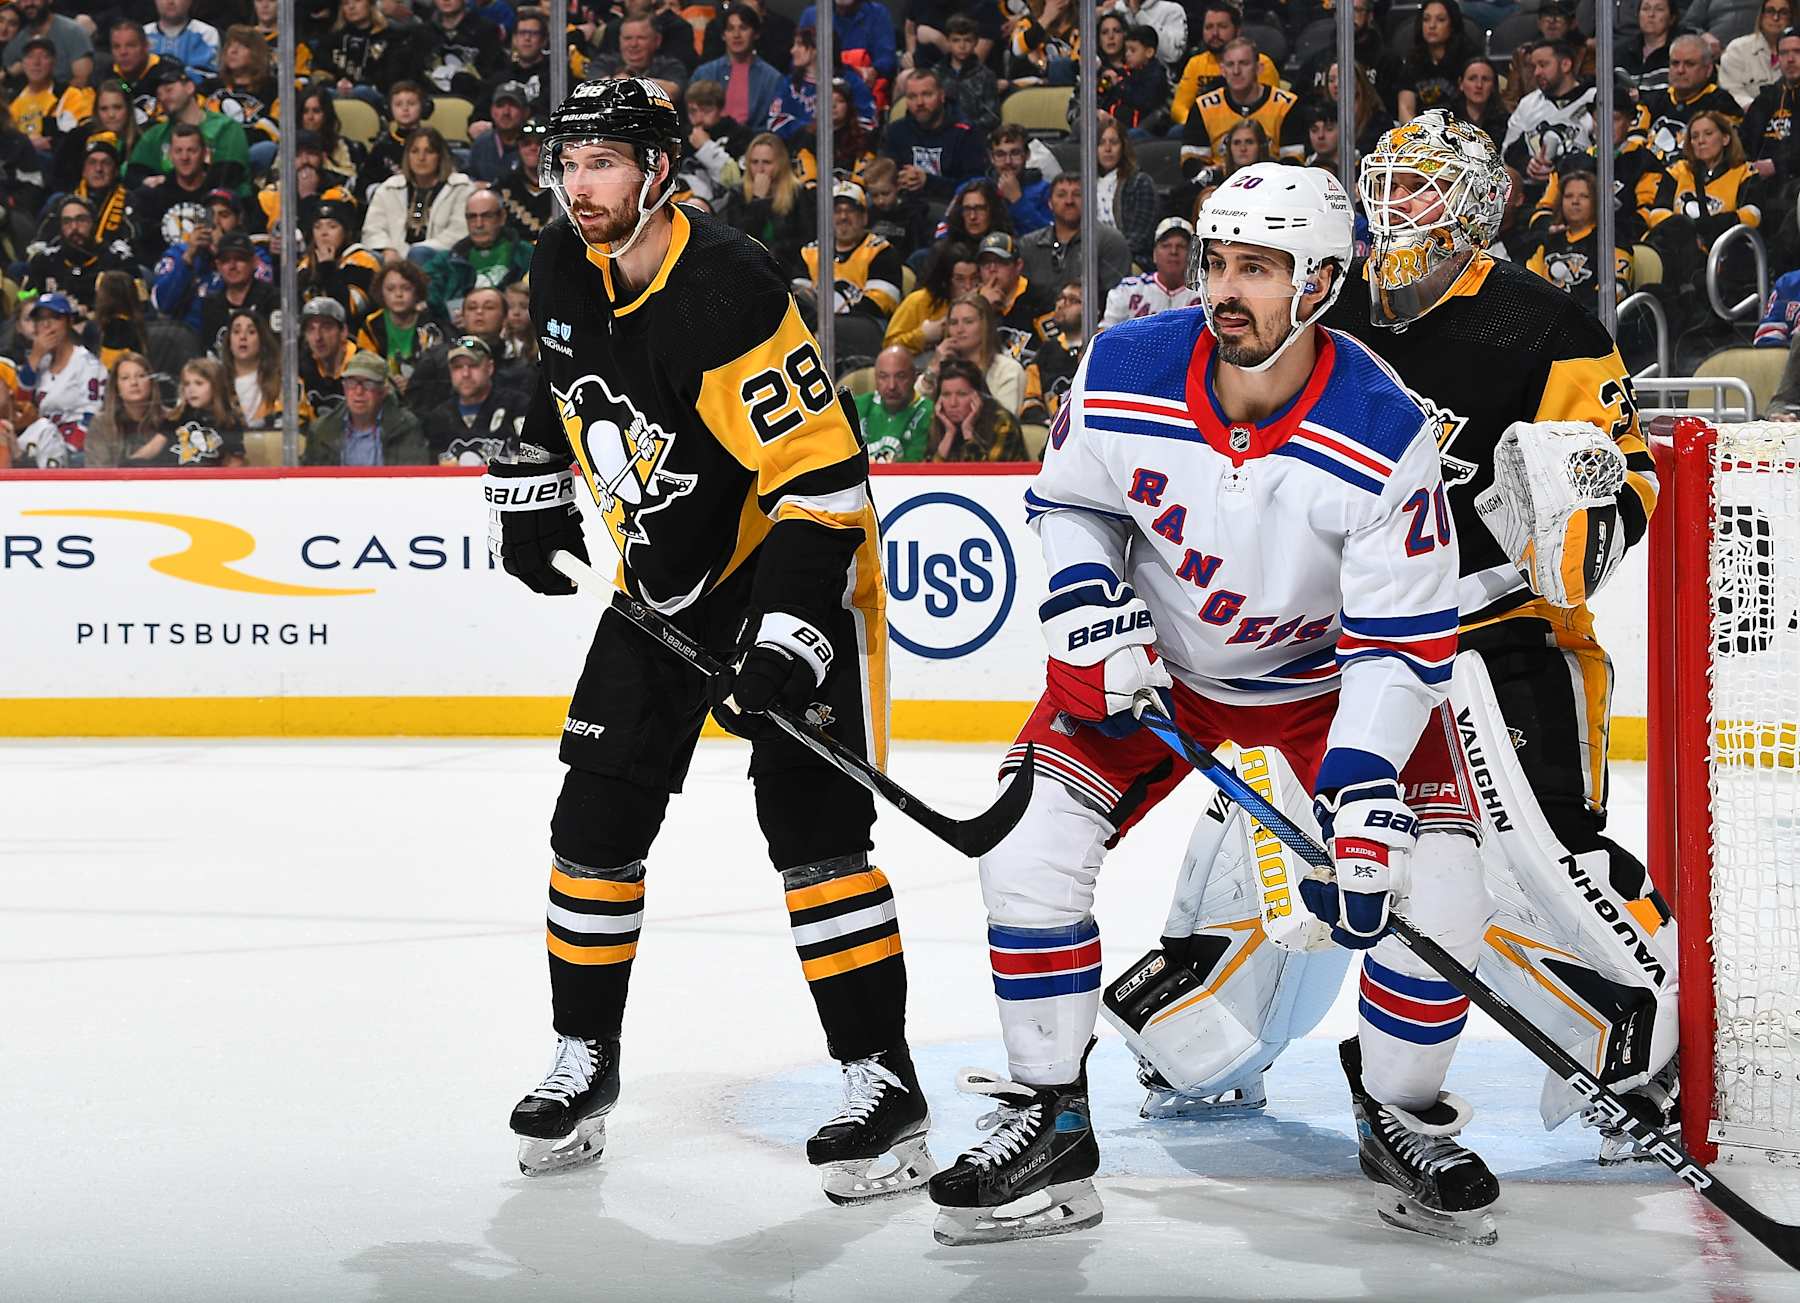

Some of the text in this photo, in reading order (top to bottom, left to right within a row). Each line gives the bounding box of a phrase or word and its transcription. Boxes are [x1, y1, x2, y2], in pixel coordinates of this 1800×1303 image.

[1231, 175, 1264, 190] 20
[1211, 208, 1248, 217] BAUER
[740, 341, 836, 446] 28
[1052, 390, 1071, 450] 0
[485, 474, 573, 506] BAUER
[1402, 480, 1451, 558] 20
[3, 535, 494, 570] RS CASI
[1128, 467, 1336, 650] RANGERS
[886, 537, 994, 618] USS
[77, 622, 329, 645] PITTSBURGH
[666, 634, 698, 661] BAUER
[1456, 706, 1513, 833] VAUGHN
[1344, 846, 1378, 859] KREIDER
[1558, 854, 1668, 988] VAUGHN
[1567, 1071, 1712, 1193] BAUER
[1010, 1152, 1047, 1185] BAUER
